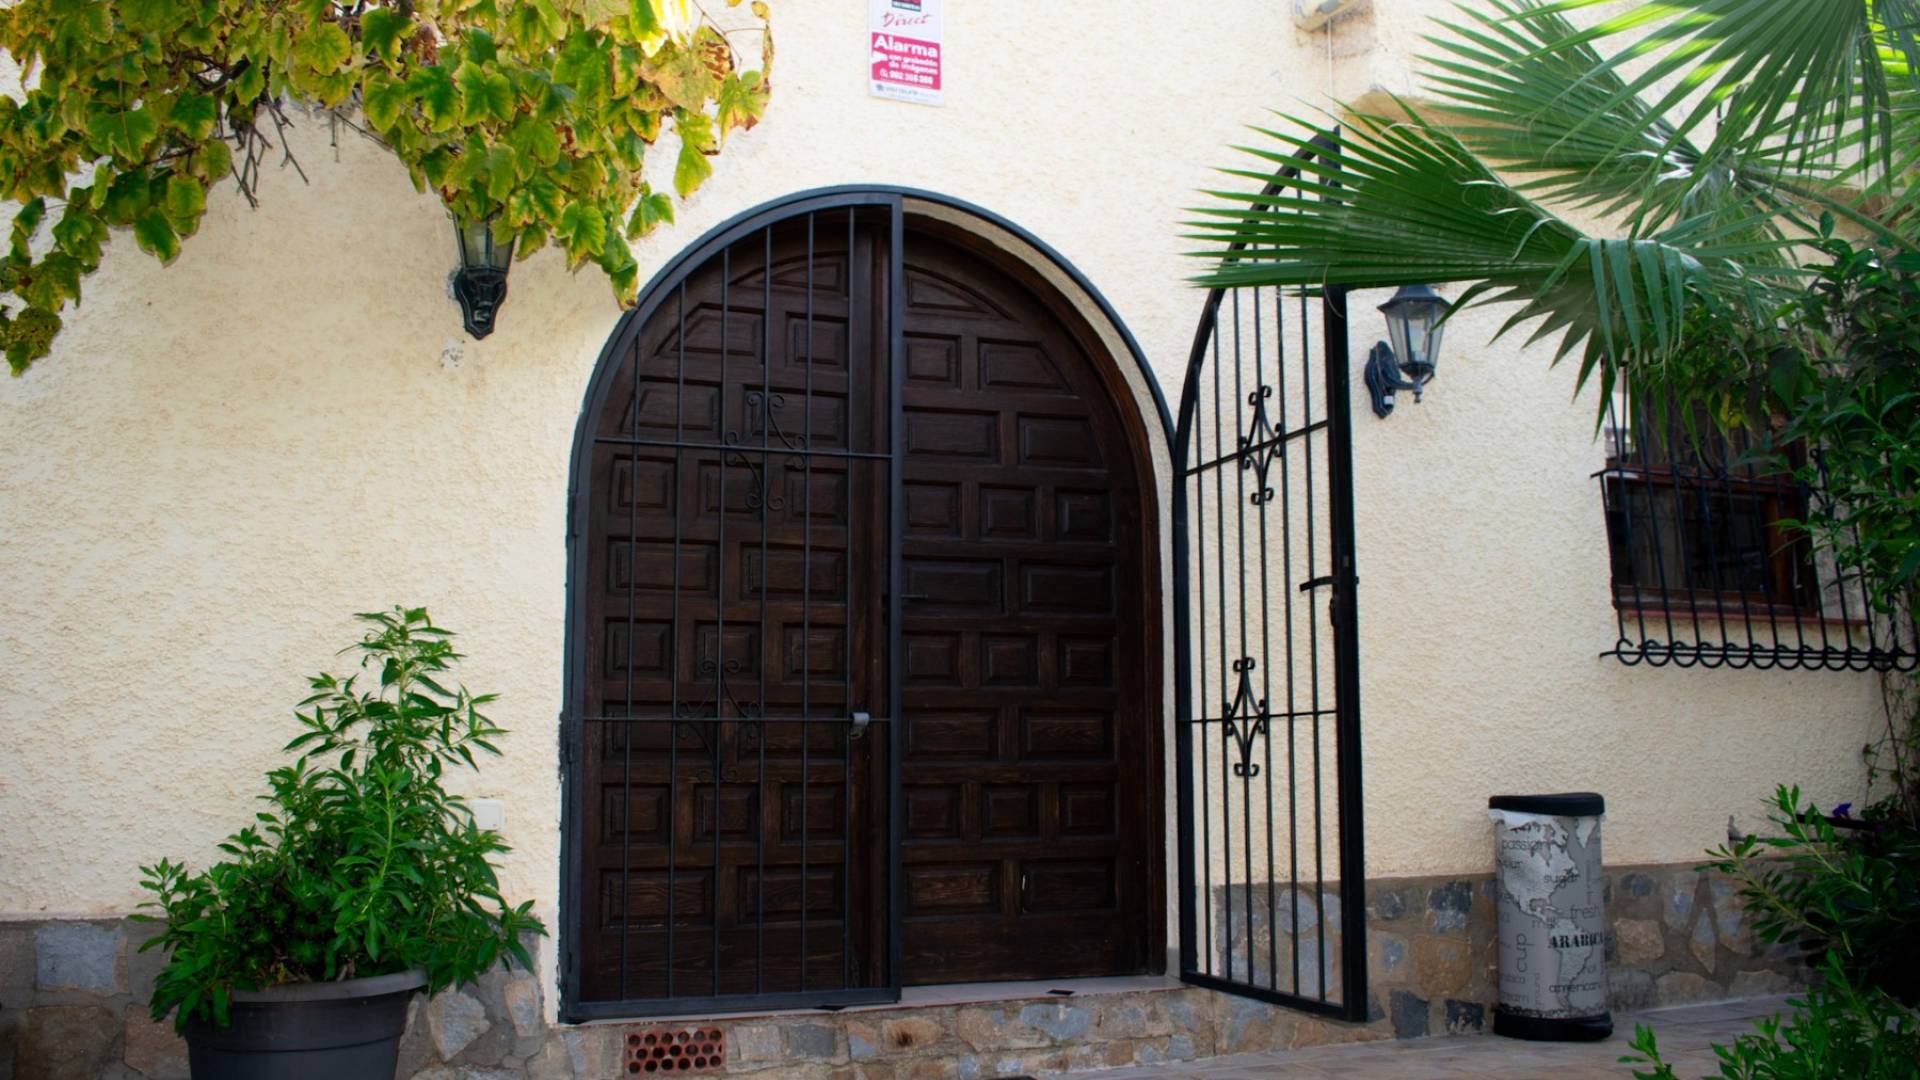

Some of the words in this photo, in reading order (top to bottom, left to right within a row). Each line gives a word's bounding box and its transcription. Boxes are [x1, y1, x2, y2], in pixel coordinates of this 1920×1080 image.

[883, 12, 934, 27] Direct
[874, 35, 938, 58] Alarma
[1544, 874, 1579, 889] sugar
[1570, 904, 1601, 919] fresh
[1516, 932, 1535, 973] cup
